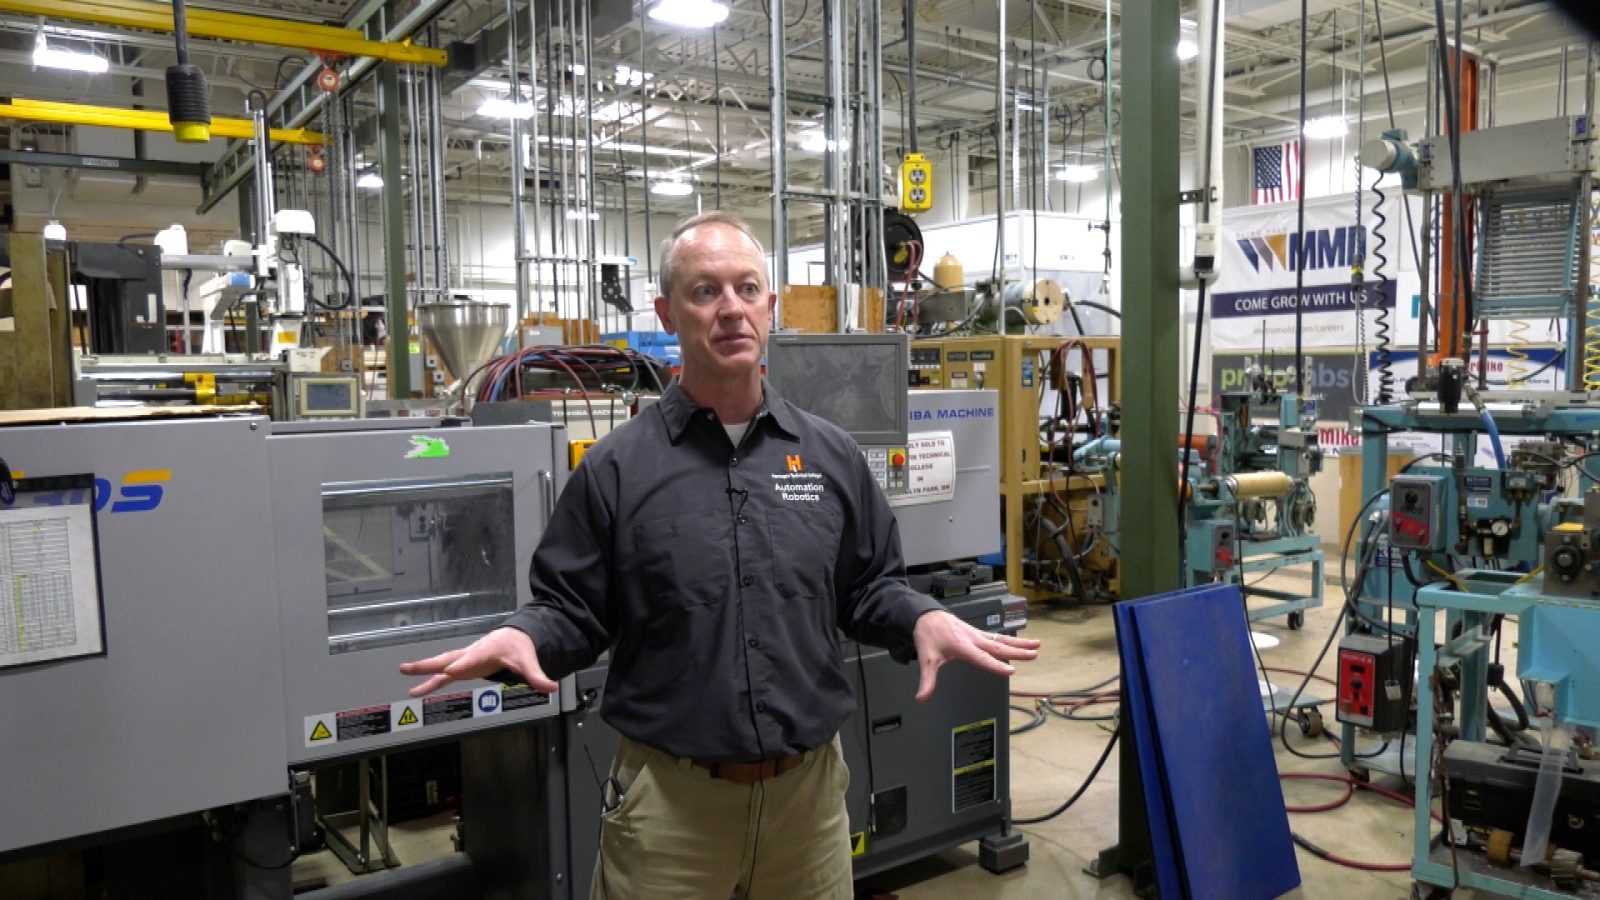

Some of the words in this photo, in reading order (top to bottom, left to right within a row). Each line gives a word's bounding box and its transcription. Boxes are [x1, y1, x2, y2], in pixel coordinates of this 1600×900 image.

[1235, 296, 1269, 311] COME
[1271, 295, 1309, 309] GROW
[1312, 291, 1346, 306] WITH
[937, 408, 994, 419] MACHINE
[919, 452, 951, 460] TECHNICAL
[774, 482, 825, 492] Automation
[782, 493, 820, 502] Robotics
